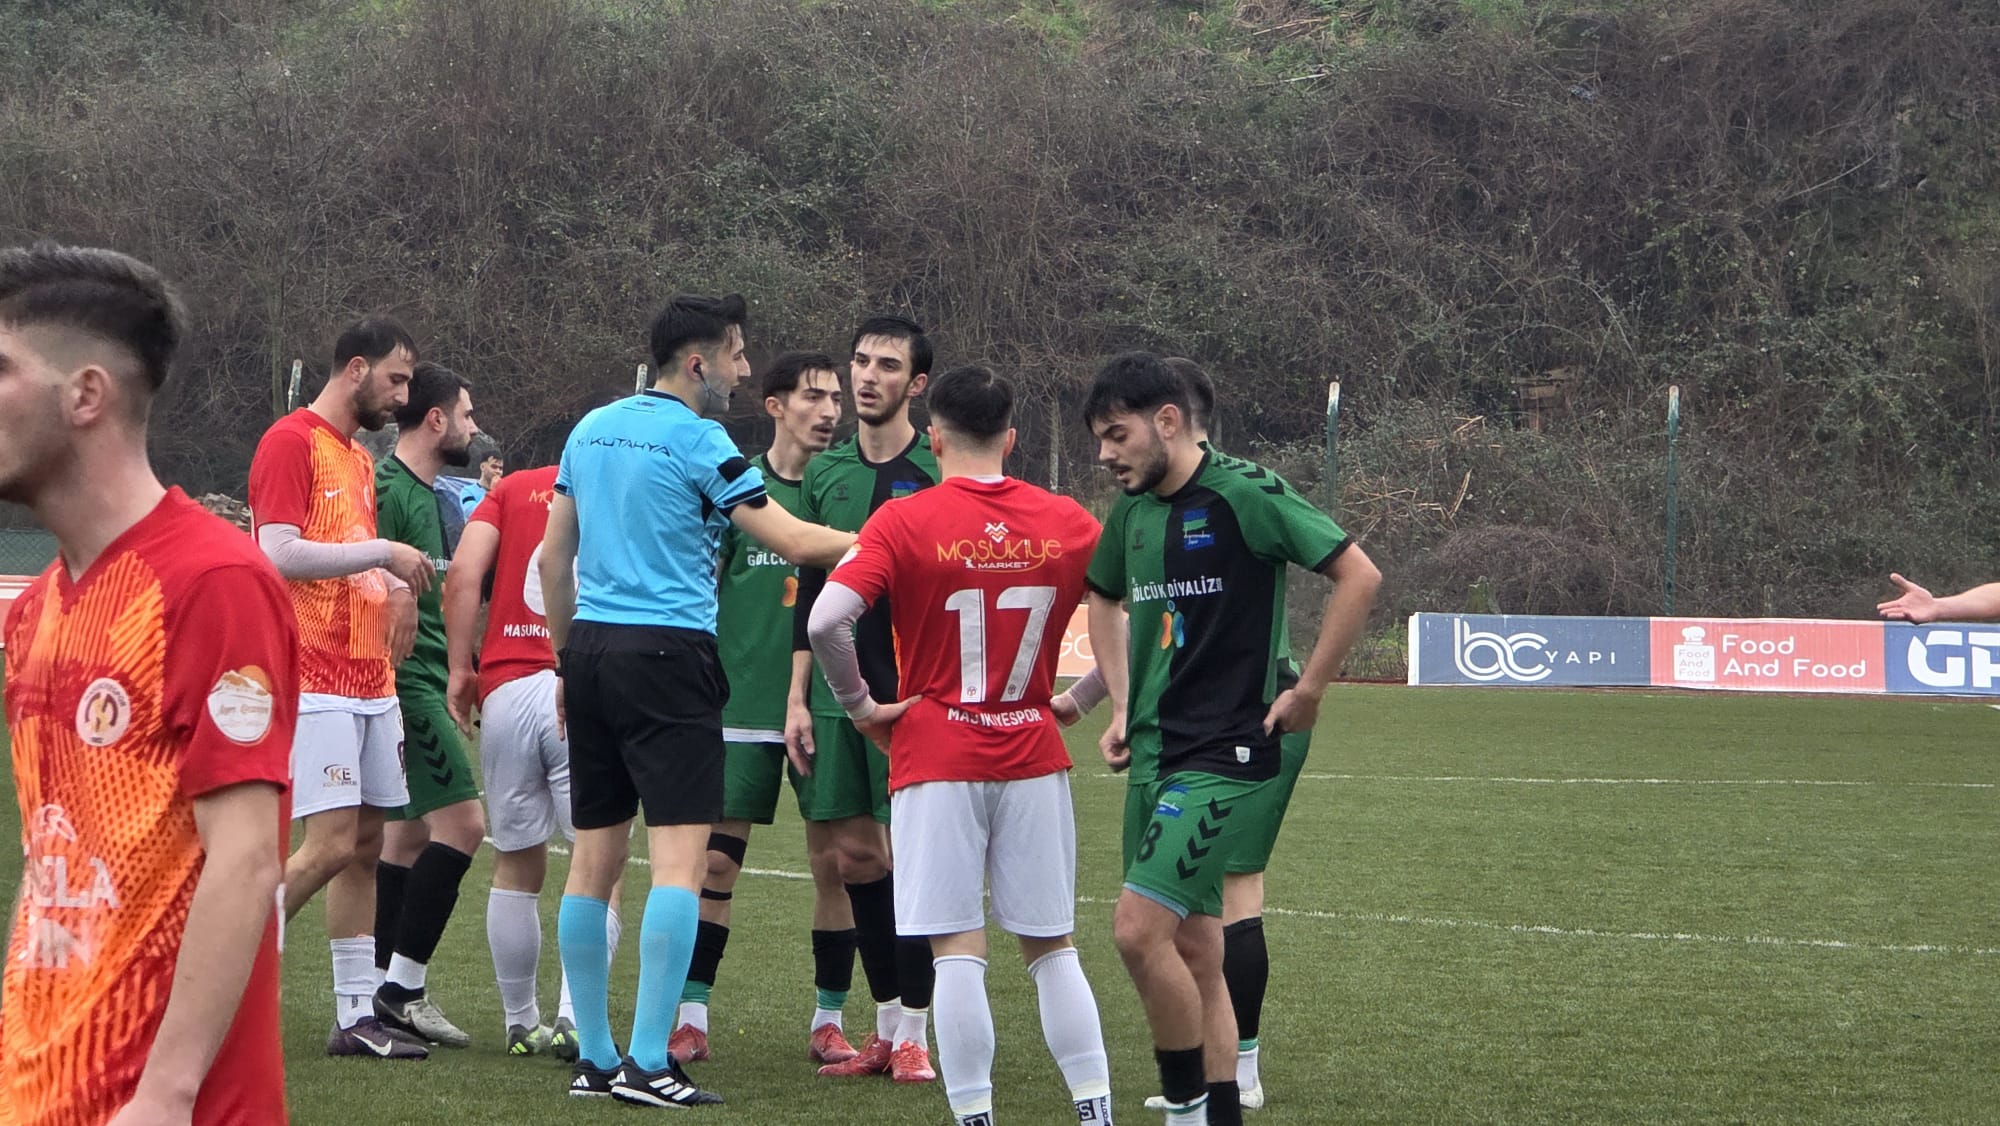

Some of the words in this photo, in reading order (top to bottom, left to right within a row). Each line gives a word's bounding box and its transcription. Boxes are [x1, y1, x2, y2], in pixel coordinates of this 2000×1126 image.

[747, 551, 792, 567] GÖLC
[977, 561, 1031, 570] MARKET
[945, 586, 1057, 703] 17
[1722, 634, 1795, 655] Food
[1544, 650, 1616, 665] YAPI
[1678, 649, 1711, 659] Food
[1678, 658, 1704, 668] And
[1723, 657, 1780, 677] And
[1793, 659, 1867, 678] Food
[1678, 668, 1711, 678] Food
[1136, 821, 1163, 864] 8
